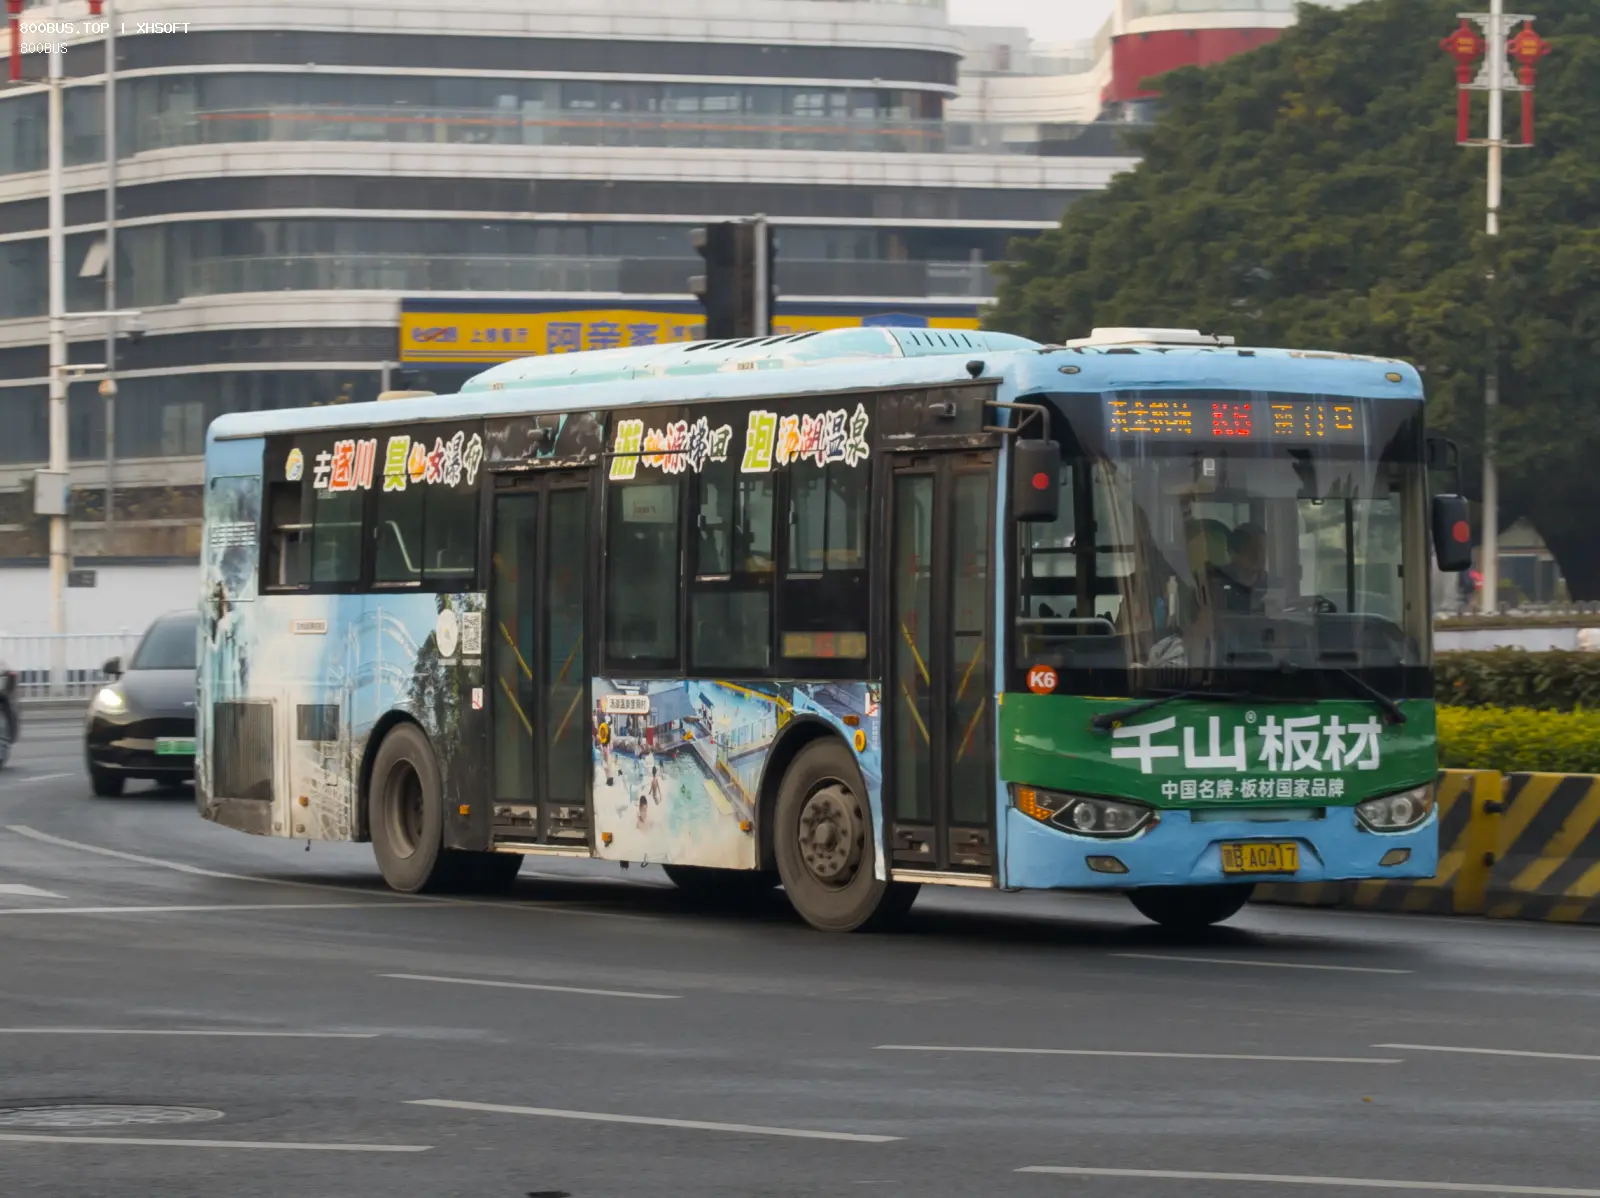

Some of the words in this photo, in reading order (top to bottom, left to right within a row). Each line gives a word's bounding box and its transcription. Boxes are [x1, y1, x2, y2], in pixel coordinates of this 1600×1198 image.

[1211, 402, 1250, 436] K6
[1271, 404, 1353, 437] 南门口
[313, 438, 377, 492] 去遂川
[608, 415, 733, 480] 游桃源梯田
[741, 403, 869, 473] 泡汤湖温泉
[1030, 671, 1056, 689] K6
[1161, 778, 1345, 801] 中国名牌·板材国家品牌
